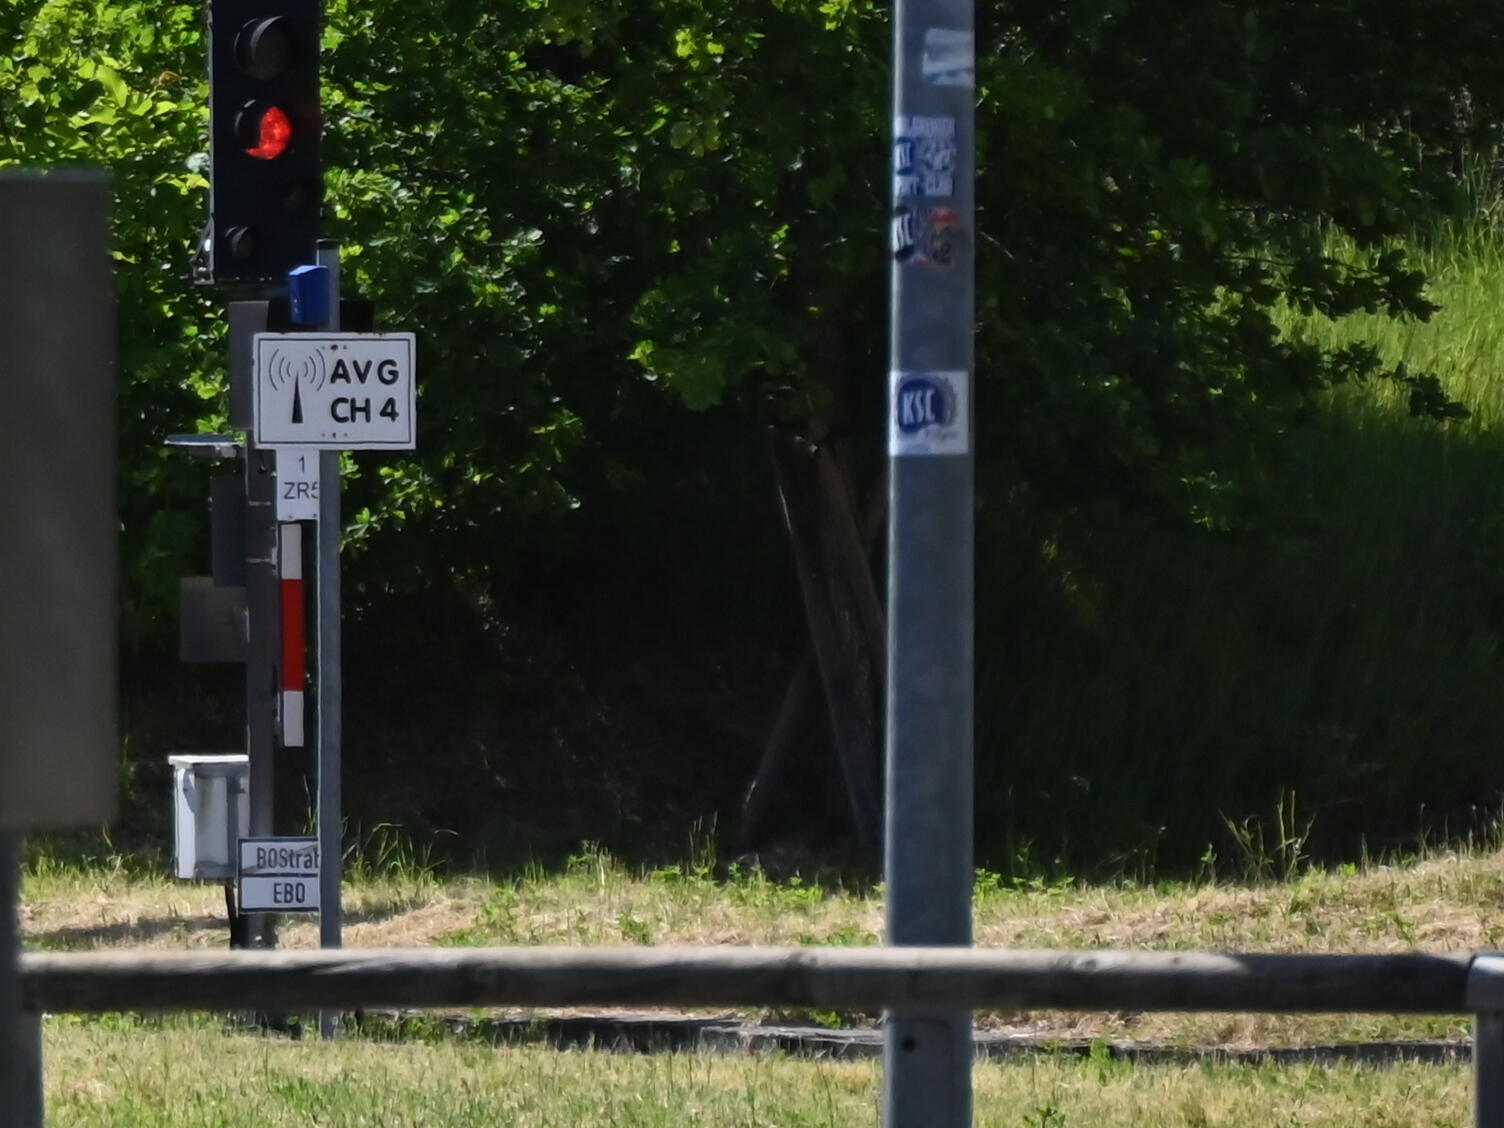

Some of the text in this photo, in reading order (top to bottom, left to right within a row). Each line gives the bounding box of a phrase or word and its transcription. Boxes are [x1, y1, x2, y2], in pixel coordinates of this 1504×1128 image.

[330, 358, 399, 385] AVG
[330, 397, 399, 423] CH 4
[903, 389, 935, 424] KSC
[298, 455, 305, 473] 1
[273, 882, 305, 904] EBO
